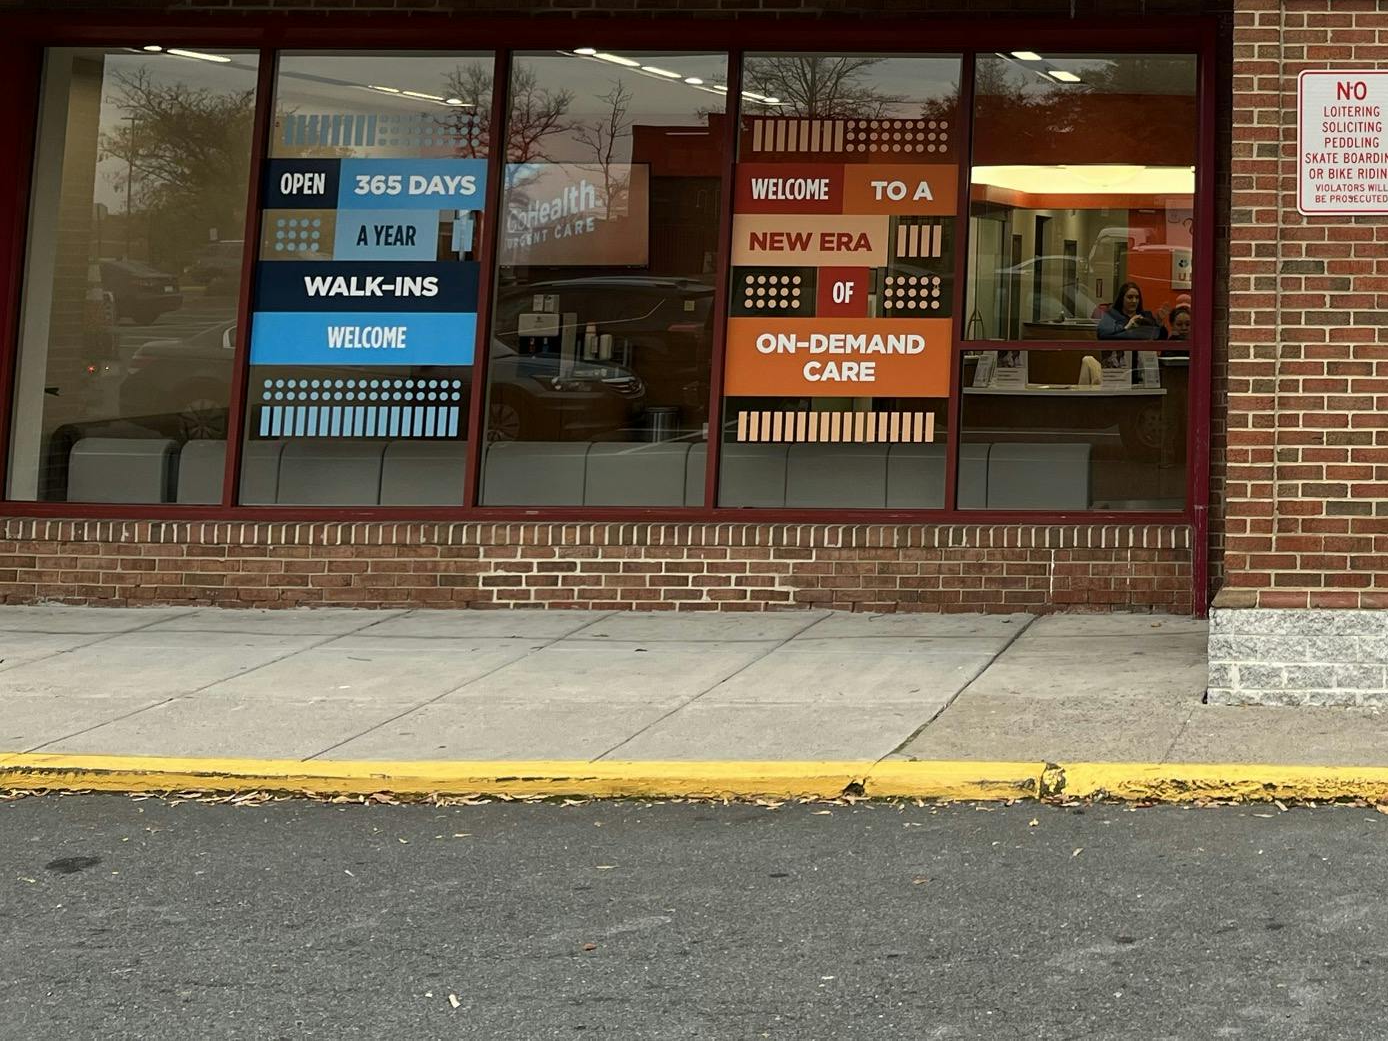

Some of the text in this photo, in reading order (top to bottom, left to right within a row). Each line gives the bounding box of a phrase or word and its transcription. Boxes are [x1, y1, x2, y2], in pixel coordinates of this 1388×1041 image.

[1336, 81, 1368, 101] NO
[1323, 106, 1381, 118] LOITERING
[1321, 121, 1383, 133] SOLICITING
[1324, 137, 1380, 149] PEDDLING
[1304, 152, 1339, 164] SKATE
[280, 172, 326, 195] OPEN
[1308, 168, 1324, 180] OR
[1328, 168, 1353, 180] BIKE
[354, 175, 477, 195] 365 DAYS
[751, 178, 829, 200] WELCOME
[870, 180, 933, 201] TO A
[1315, 183, 1388, 192] VIOLATORS WILL
[1315, 194, 1388, 203] BE PROSECUTED
[356, 224, 417, 246] A YEAR
[554, 216, 596, 240] CARE
[748, 231, 873, 252] NEW ERA
[304, 276, 439, 297] WALK-INS
[832, 281, 855, 304] OF
[327, 326, 407, 348] WELCOME
[755, 333, 926, 355] ON-DEMAND
[803, 361, 876, 382] CARE
